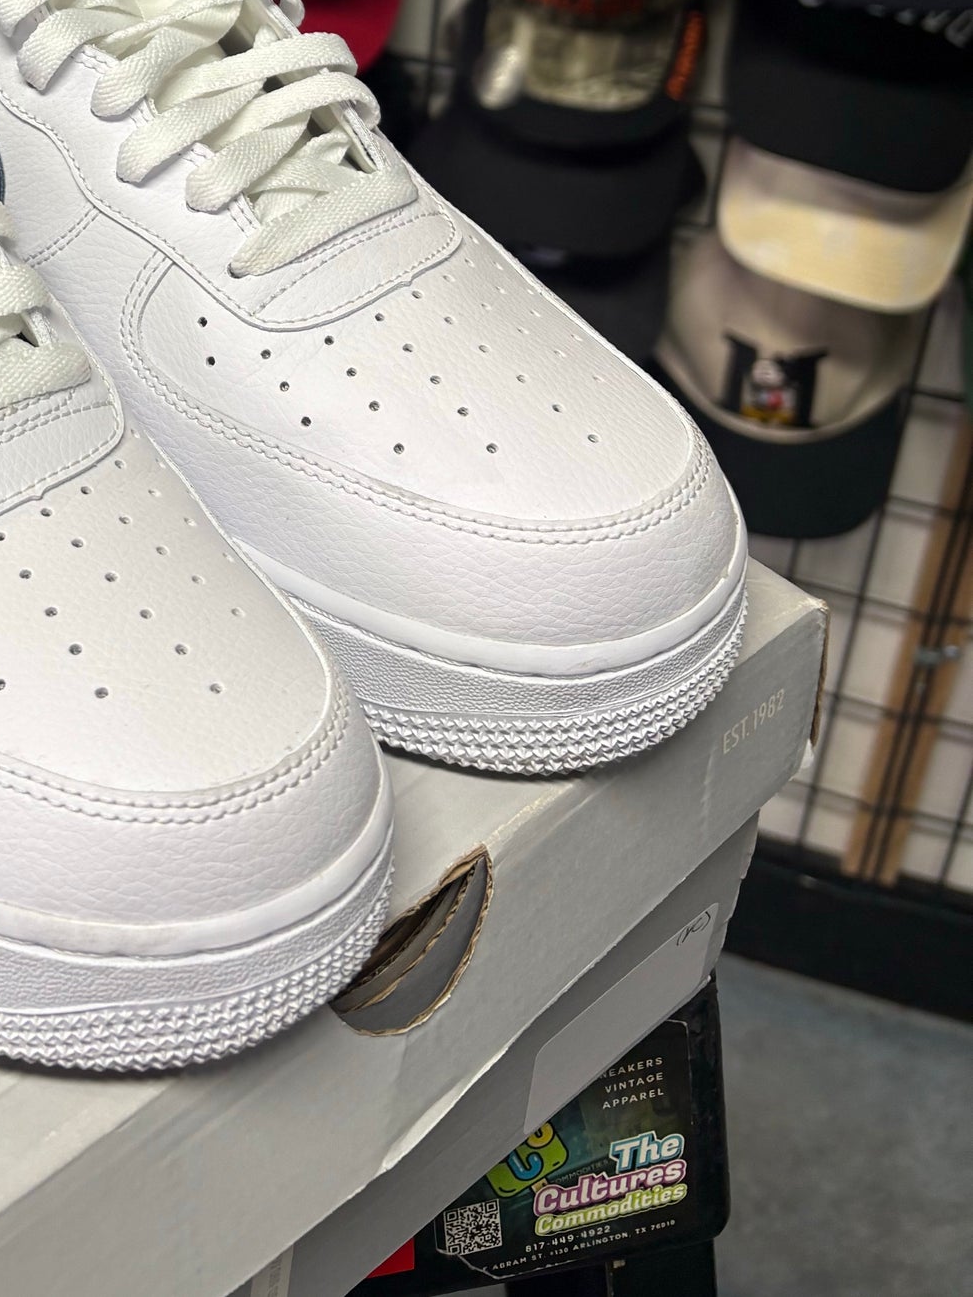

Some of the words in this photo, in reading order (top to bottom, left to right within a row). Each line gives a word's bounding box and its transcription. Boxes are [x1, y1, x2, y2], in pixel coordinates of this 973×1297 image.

[723, 715, 750, 755] EST.
[752, 688, 785, 731] 1982
[602, 1088, 665, 1110] APPAREL
[604, 1072, 664, 1094] VINTAGE
[610, 1132, 684, 1173] The
[535, 1160, 686, 1214] Cultures
[536, 1184, 686, 1235] Commodities
[525, 1225, 611, 1253] 817-449-4922
[634, 1227, 647, 1235] TX
